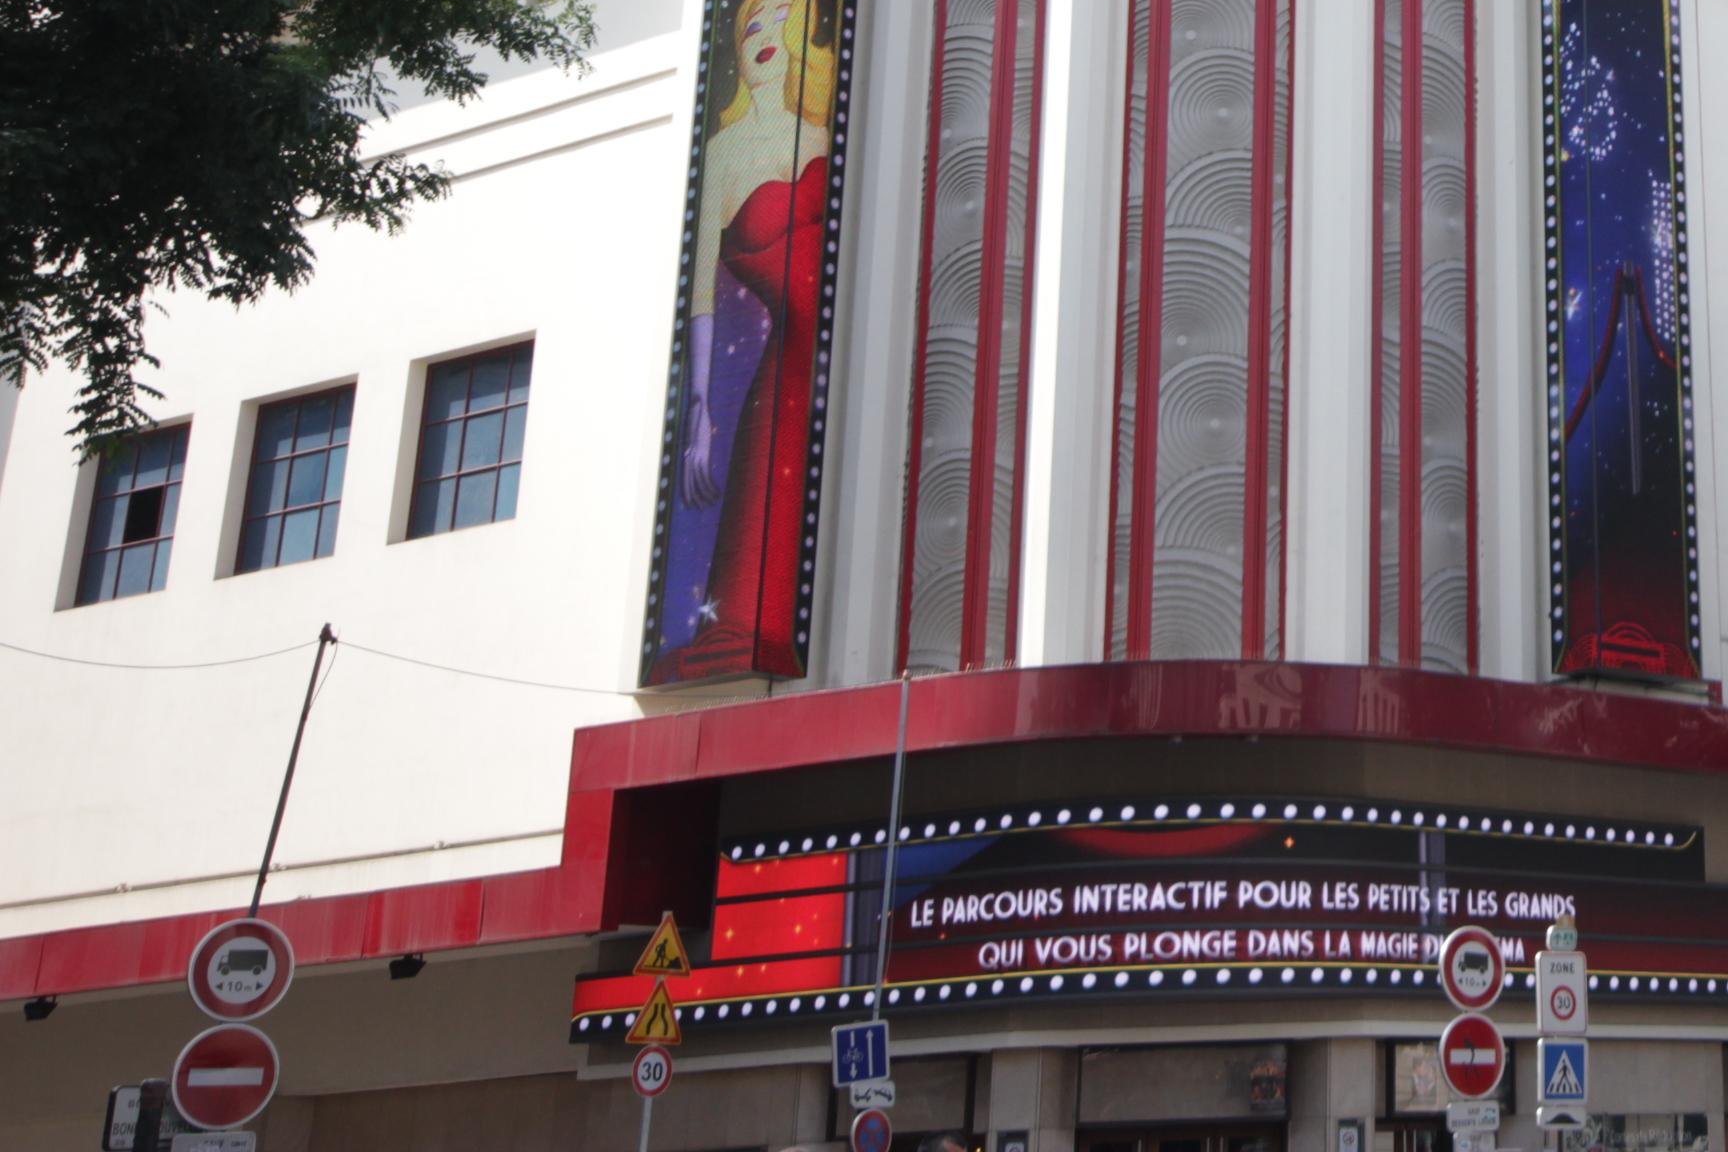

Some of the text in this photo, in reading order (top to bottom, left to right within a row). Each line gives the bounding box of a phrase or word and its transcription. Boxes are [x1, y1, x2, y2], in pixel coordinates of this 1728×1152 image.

[911, 881, 1576, 928] LE PARCOURS INTERACTIF POUR LES PETITS ET LES GRANDS
[978, 939, 1024, 969] QUI
[1035, 934, 1112, 963] VOUS
[1123, 930, 1237, 960] PLONGE
[1248, 929, 1314, 957] DANS
[1324, 931, 1349, 957] LA
[1361, 932, 1418, 960] MAGIE
[1550, 962, 1575, 975] ZONE
[1557, 996, 1571, 1010] 30
[641, 1062, 664, 1082] 30
